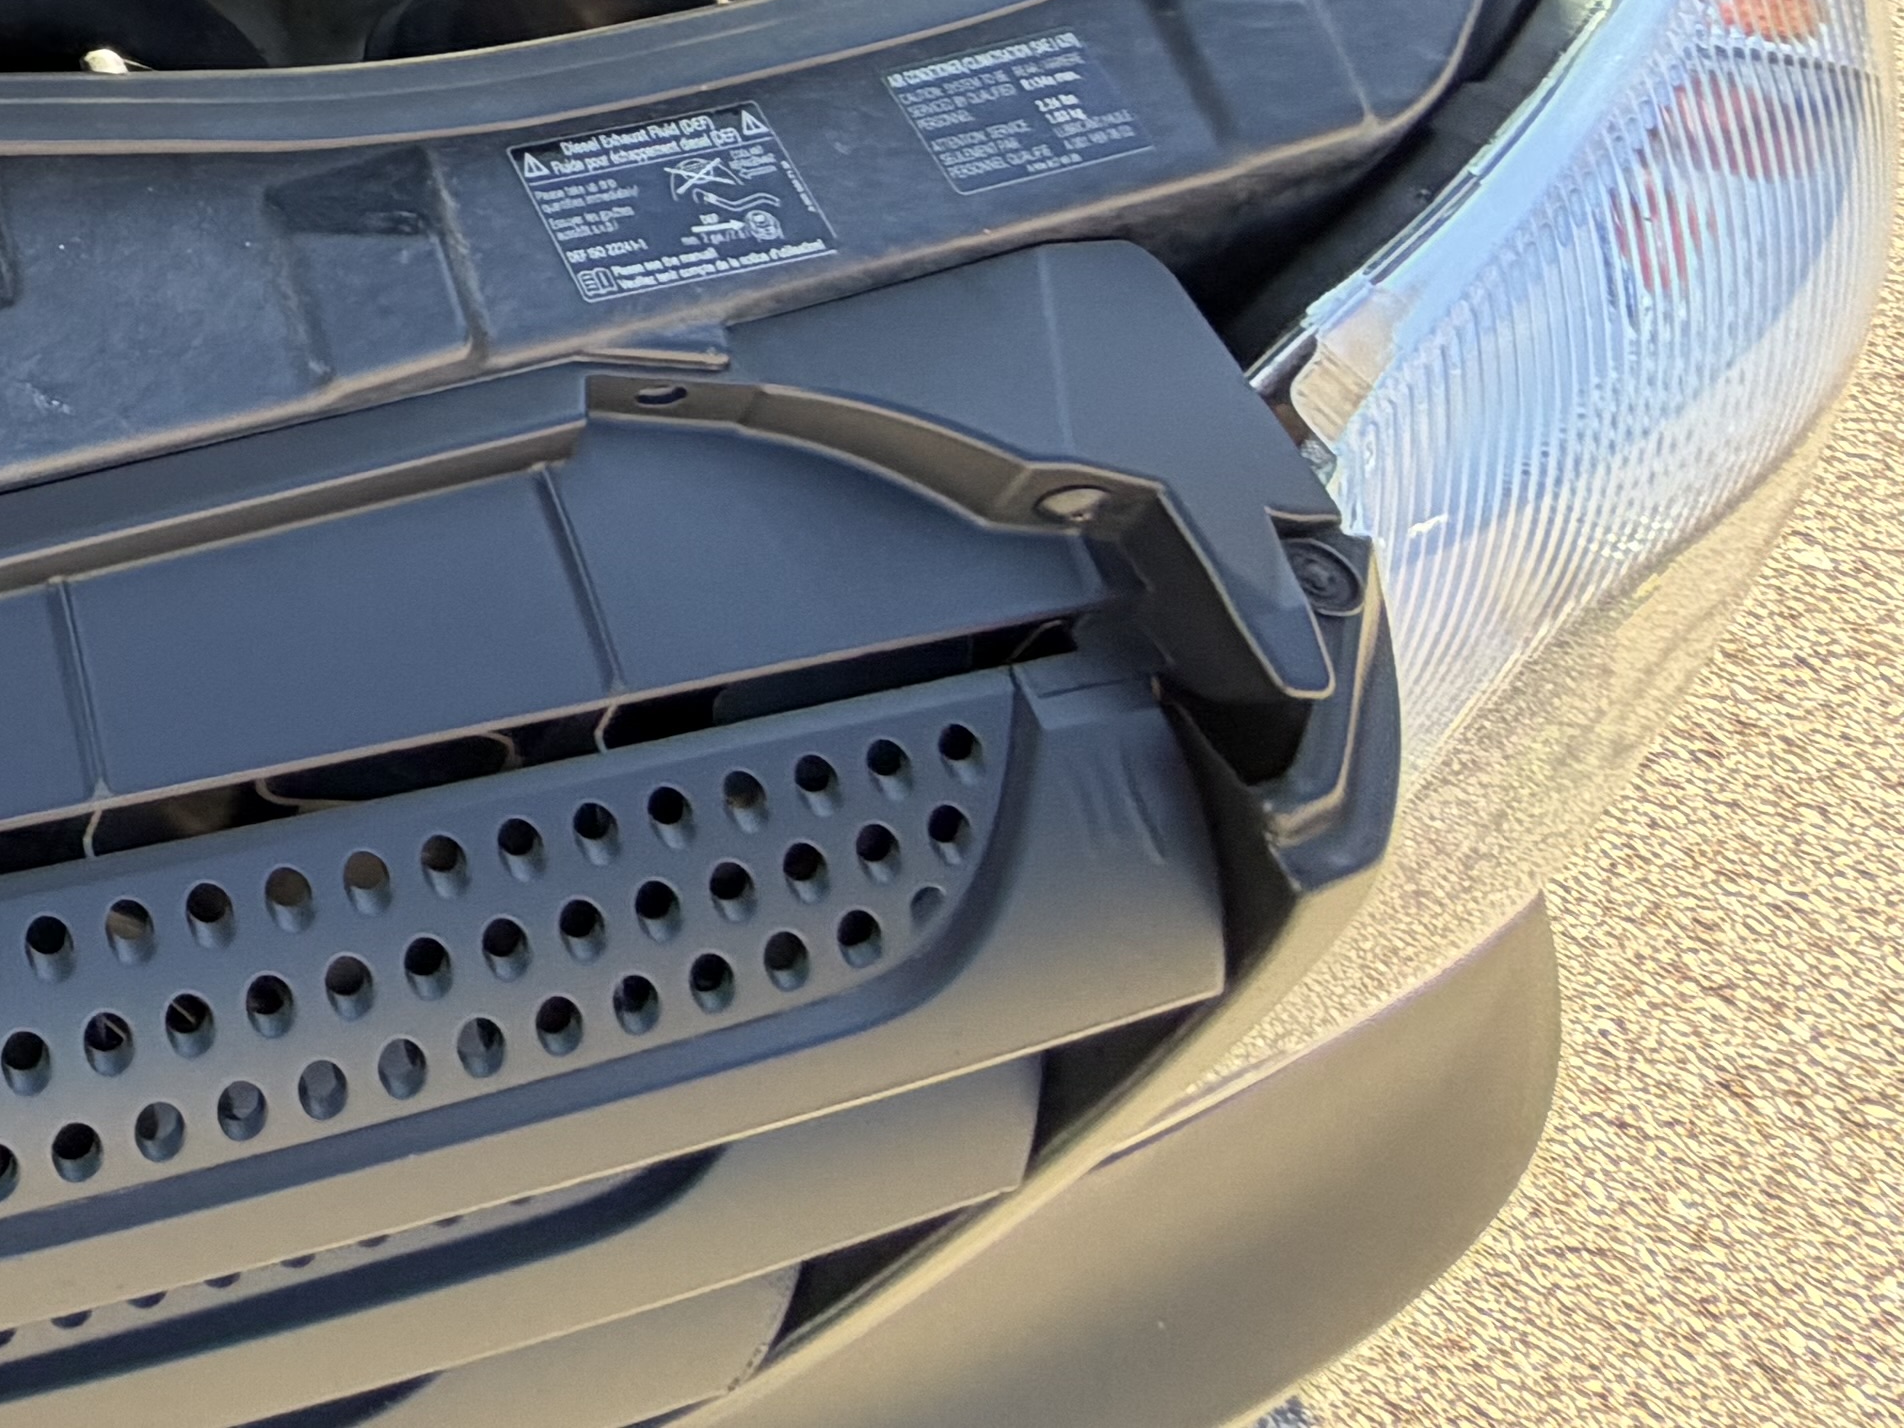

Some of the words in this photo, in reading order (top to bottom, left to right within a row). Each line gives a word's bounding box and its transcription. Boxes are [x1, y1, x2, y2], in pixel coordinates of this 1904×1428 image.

[560, 137, 602, 156] Diesel
[599, 130, 651, 149] Exhaust
[647, 123, 681, 139] Fluid
[679, 116, 715, 134] (DEF)
[551, 160, 585, 175] Fluide
[585, 155, 610, 172] pour
[680, 134, 713, 151] diesel
[710, 128, 743, 147] (DEF)
[567, 250, 587, 263] DEF
[587, 246, 607, 259] ISO
[611, 264, 646, 277] Please
